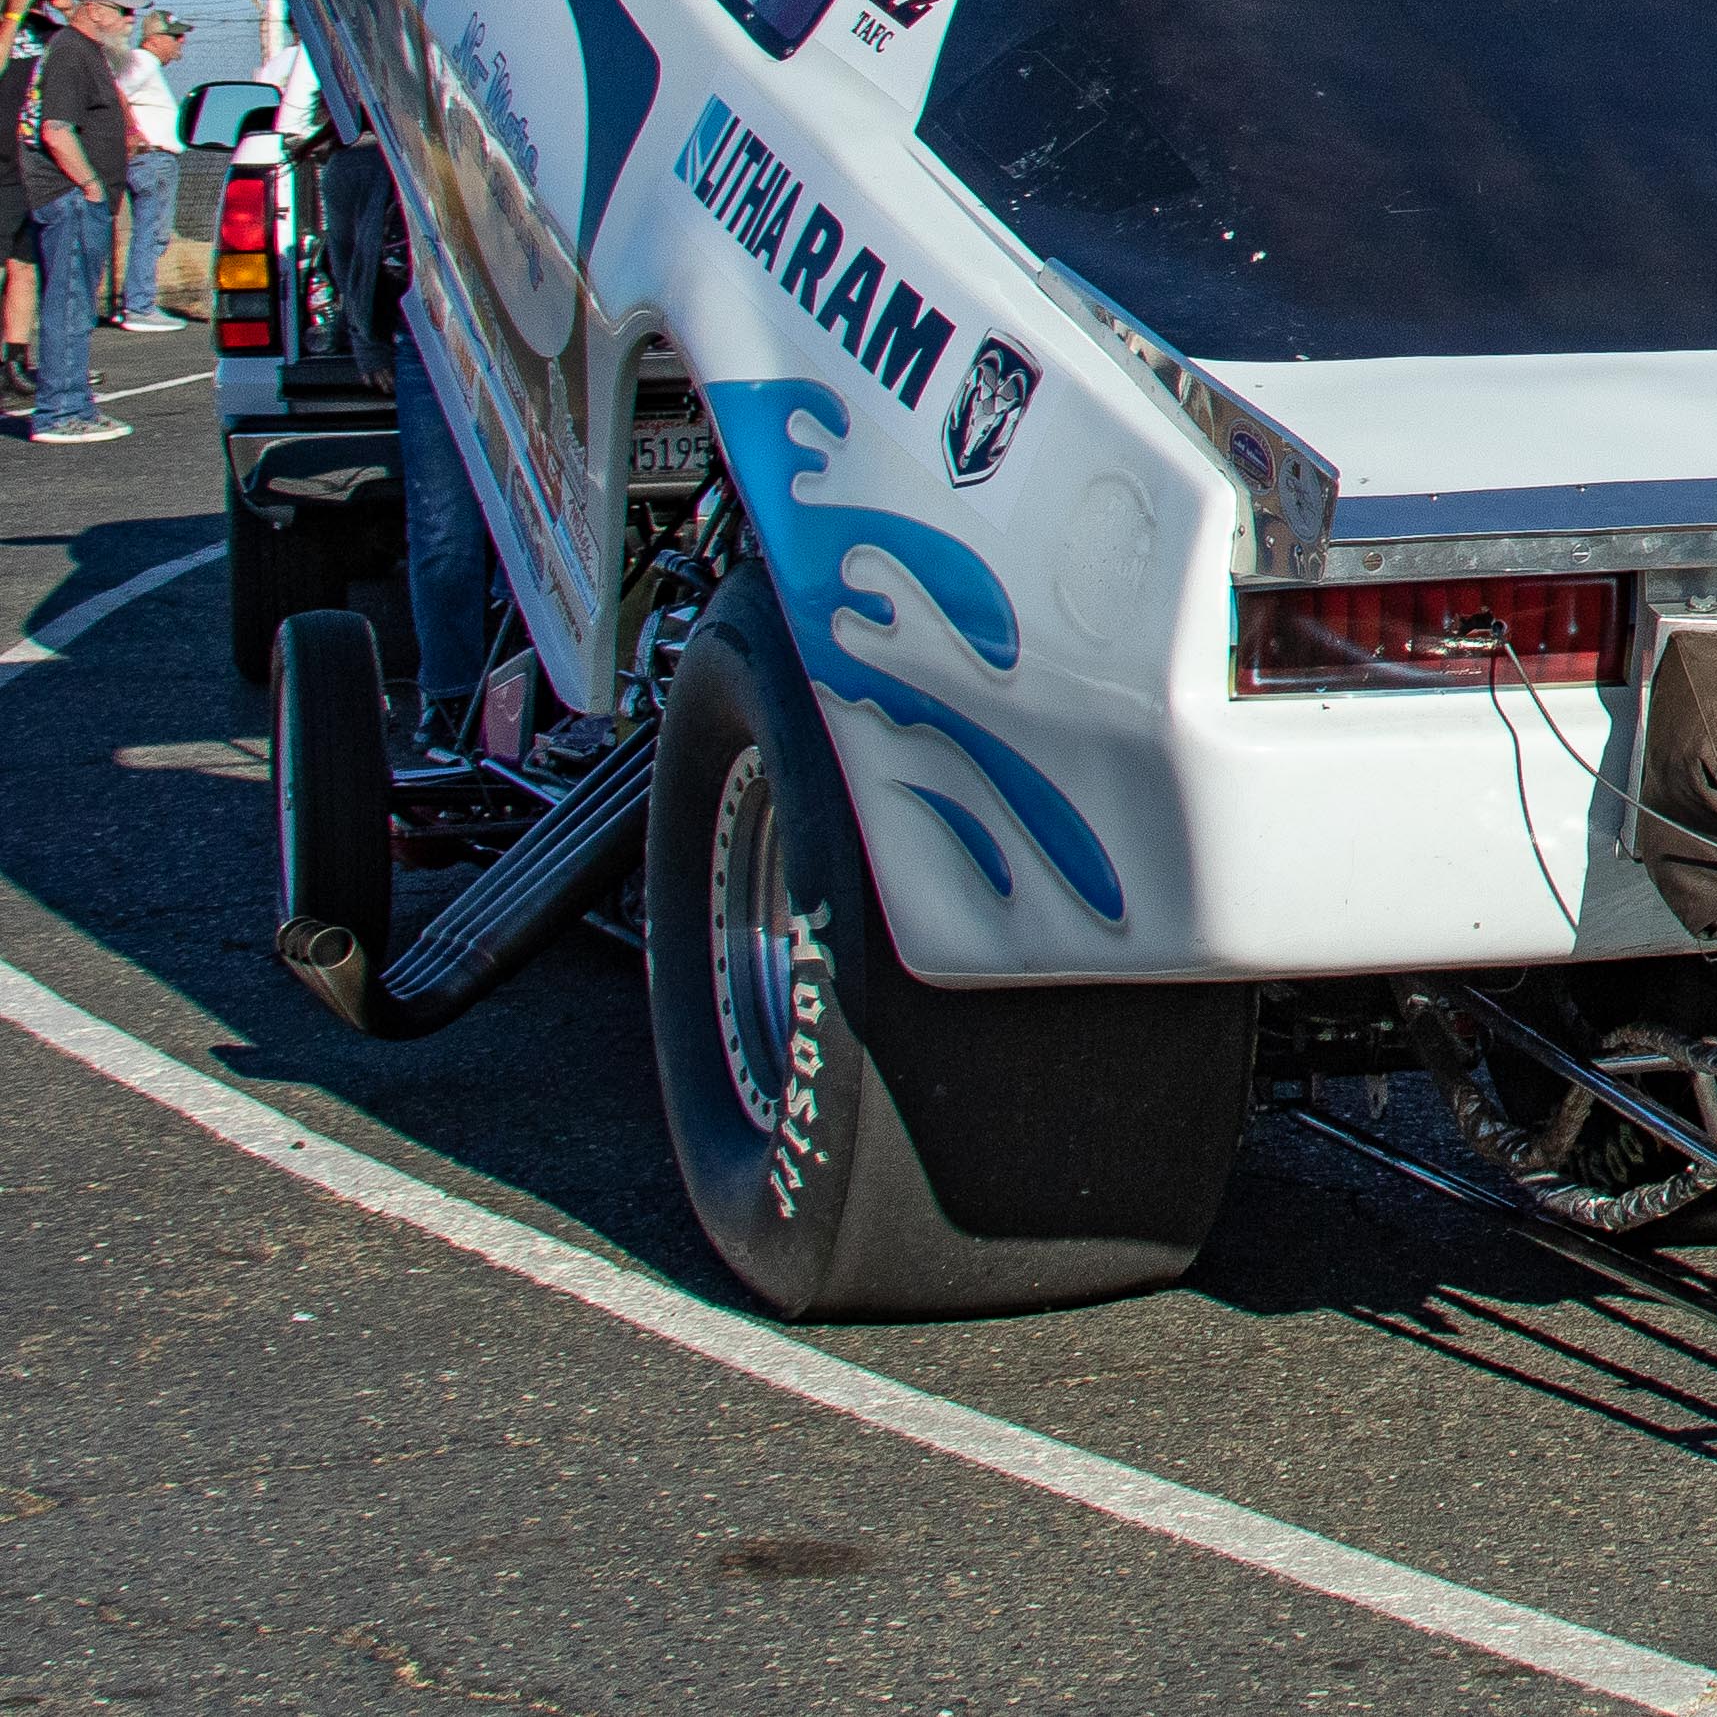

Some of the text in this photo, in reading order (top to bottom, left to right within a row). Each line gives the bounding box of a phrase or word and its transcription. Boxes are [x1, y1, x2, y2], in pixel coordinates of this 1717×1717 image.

[850, 10, 897, 54] TAFC
[693, 115, 958, 412] LITHIA RAM
[767, 896, 837, 1220] Hoosier
